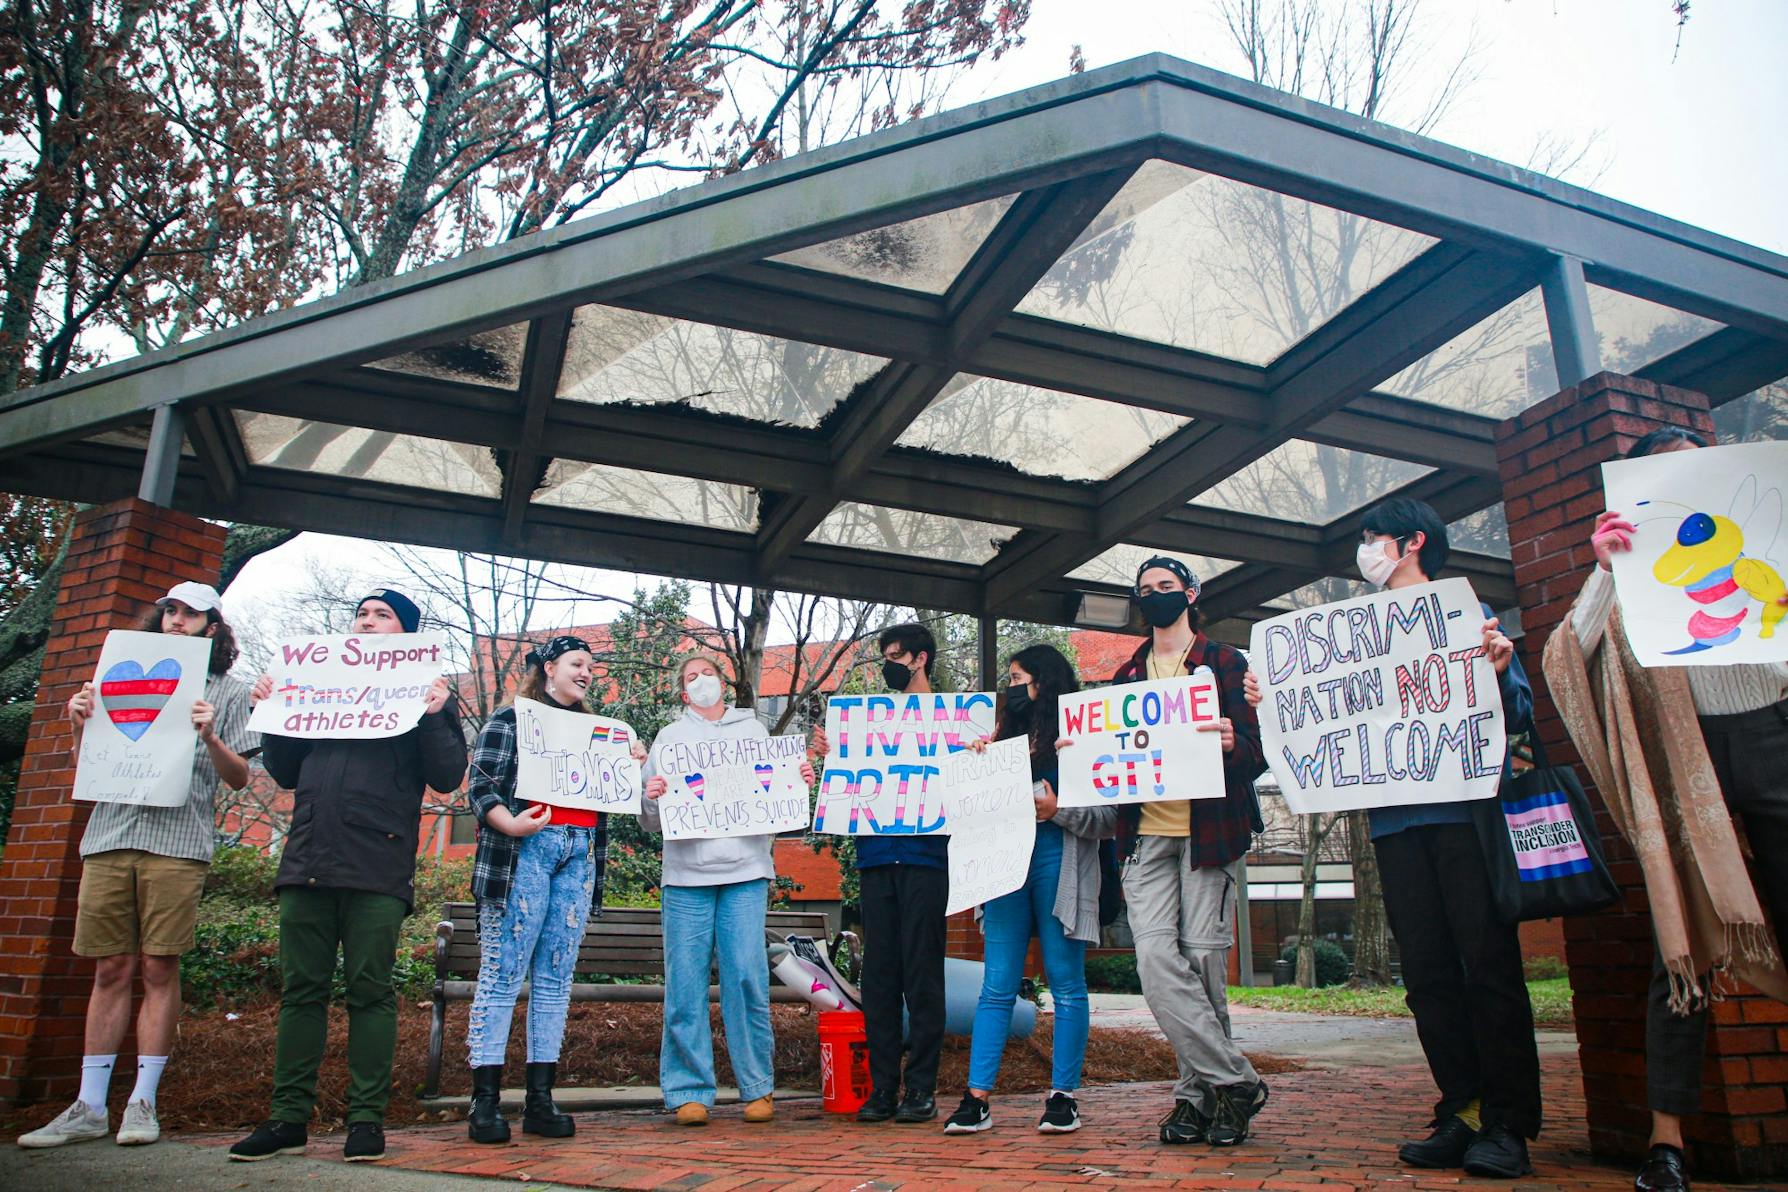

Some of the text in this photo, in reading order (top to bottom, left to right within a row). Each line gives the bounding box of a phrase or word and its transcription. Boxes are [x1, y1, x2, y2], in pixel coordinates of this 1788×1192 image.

[282, 638, 440, 671] We Support
[1266, 593, 1462, 685] DISCRIMI-
[1065, 685, 1214, 736] WELCOME
[1275, 646, 1488, 733] NATION NOT
[284, 710, 399, 732] athletes
[829, 694, 994, 758] TRANS
[1115, 730, 1149, 750] TO
[540, 748, 633, 804] THOMAS
[1092, 750, 1166, 798] GT!
[1282, 711, 1501, 789] WELCOME
[664, 796, 809, 835] PREVENTS SUICIDE
[814, 764, 946, 834] PRID
